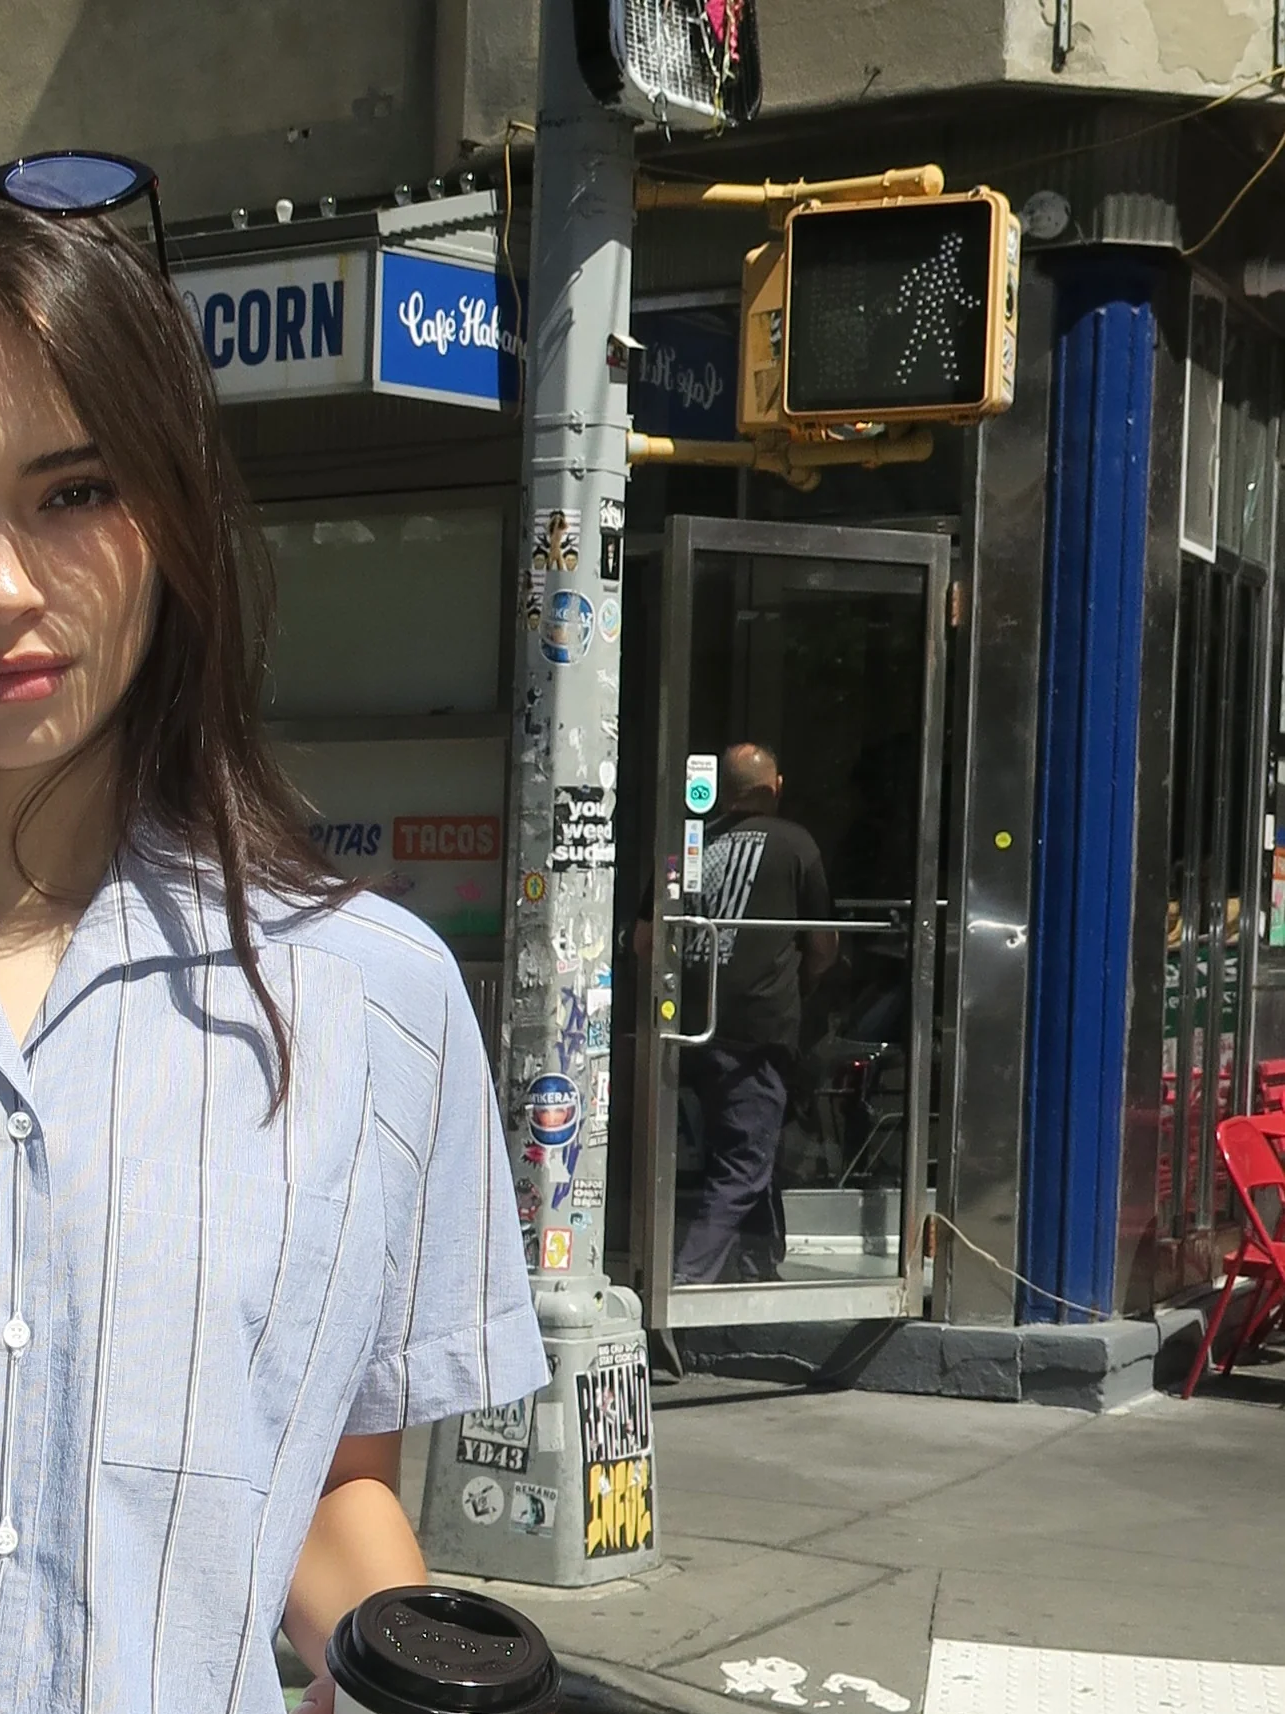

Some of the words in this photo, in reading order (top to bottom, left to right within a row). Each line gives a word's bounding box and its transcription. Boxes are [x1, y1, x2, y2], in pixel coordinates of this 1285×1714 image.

[204, 280, 345, 369] CORN
[400, 291, 456, 356] Café
[401, 824, 494, 854] TACOS
[464, 1439, 523, 1470] YD43
